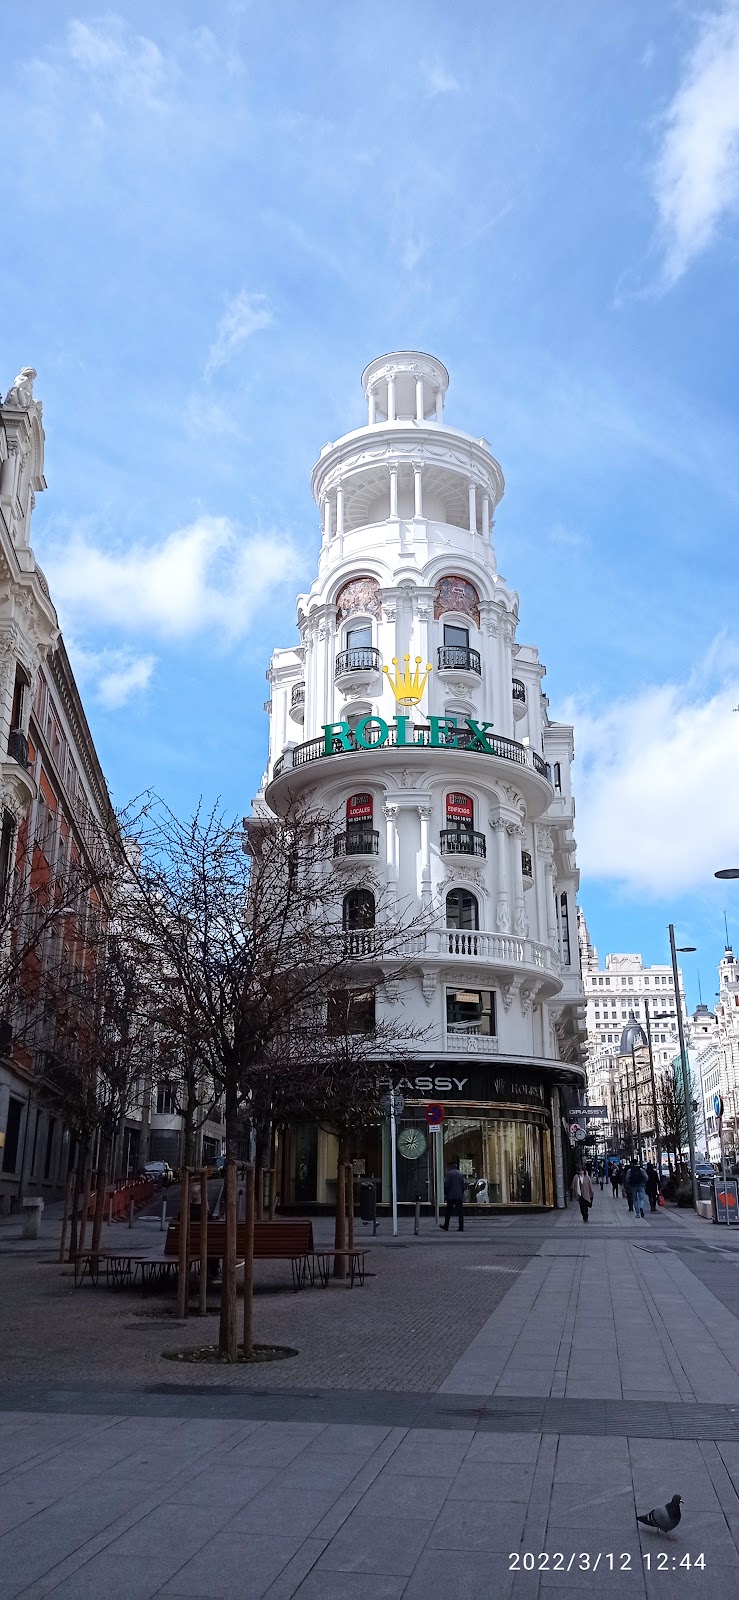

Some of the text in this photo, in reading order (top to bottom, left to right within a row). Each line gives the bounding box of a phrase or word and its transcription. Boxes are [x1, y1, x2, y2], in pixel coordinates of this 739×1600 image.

[321, 715, 496, 756] ROLEX
[350, 806, 370, 815] LOCALES
[447, 805, 470, 815] EDIFICIOS
